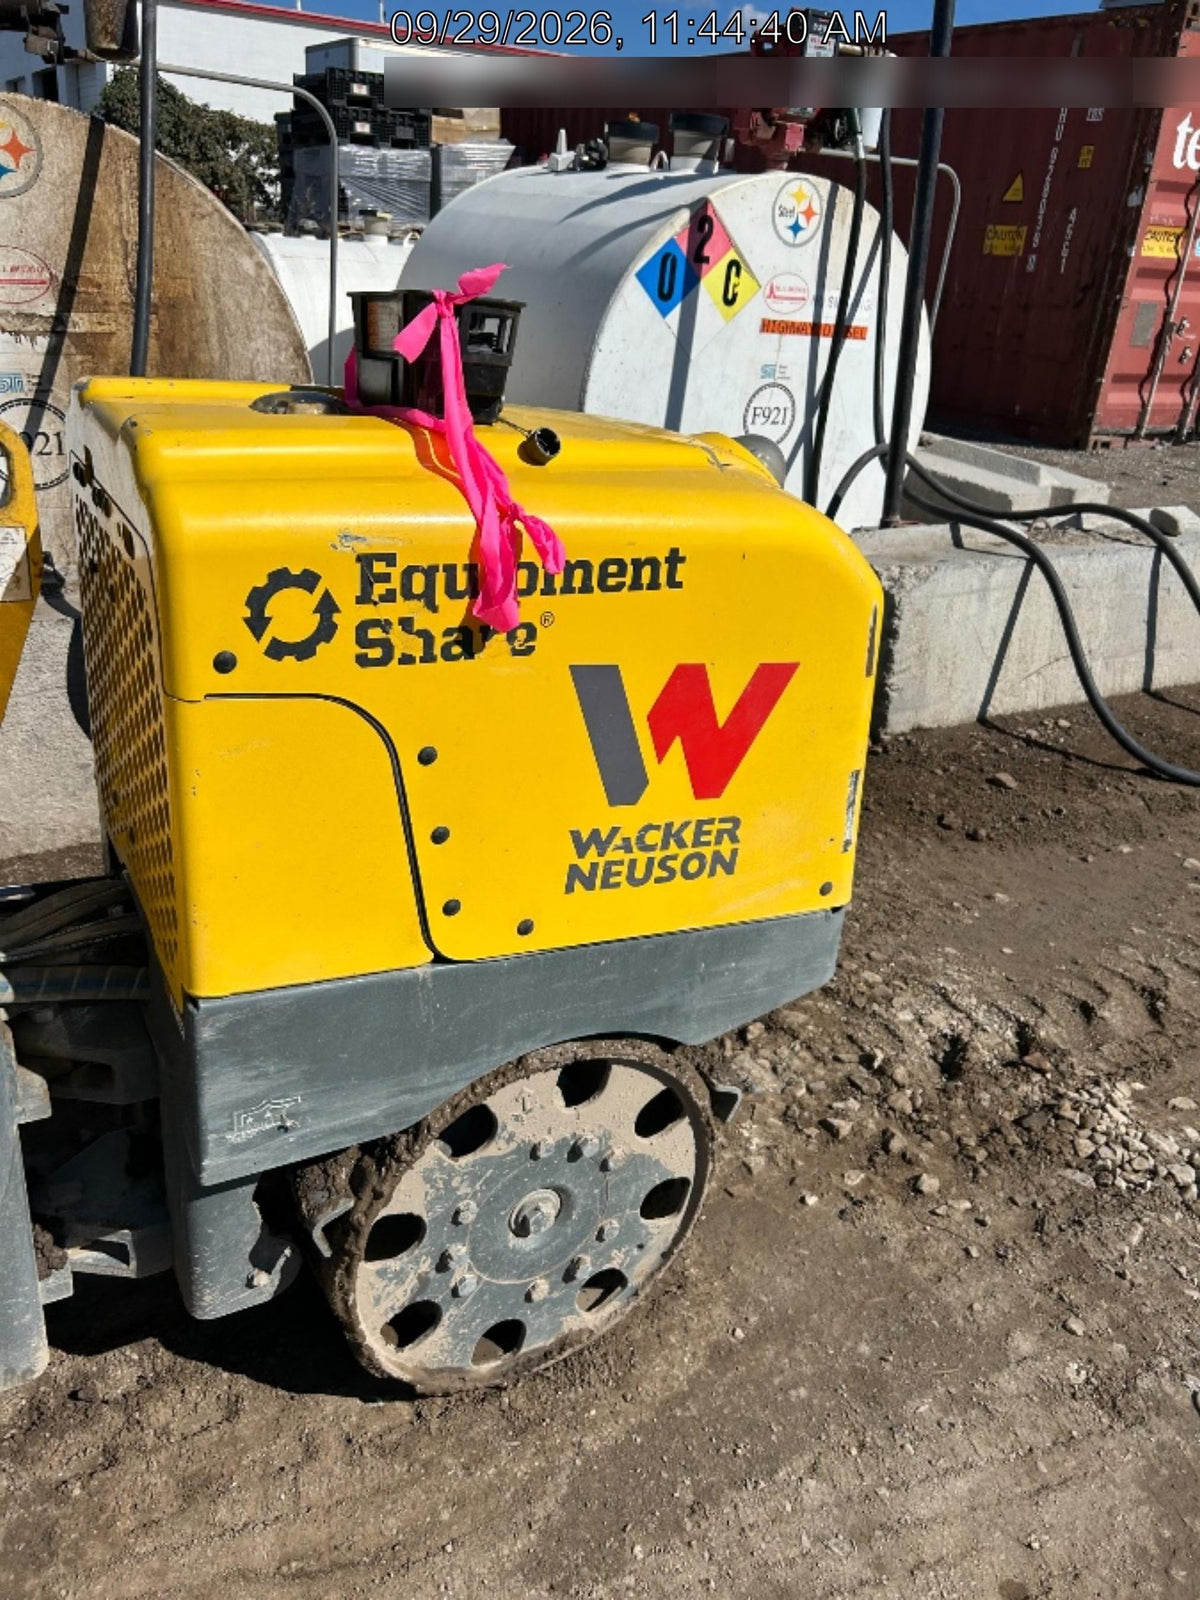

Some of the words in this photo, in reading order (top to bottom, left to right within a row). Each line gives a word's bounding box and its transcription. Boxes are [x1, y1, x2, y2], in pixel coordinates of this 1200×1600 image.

[693, 214, 714, 265] 2
[657, 252, 677, 302] 0
[750, 406, 789, 426] F921
[569, 816, 742, 859] WACKER
[564, 847, 739, 894] NEUSON
